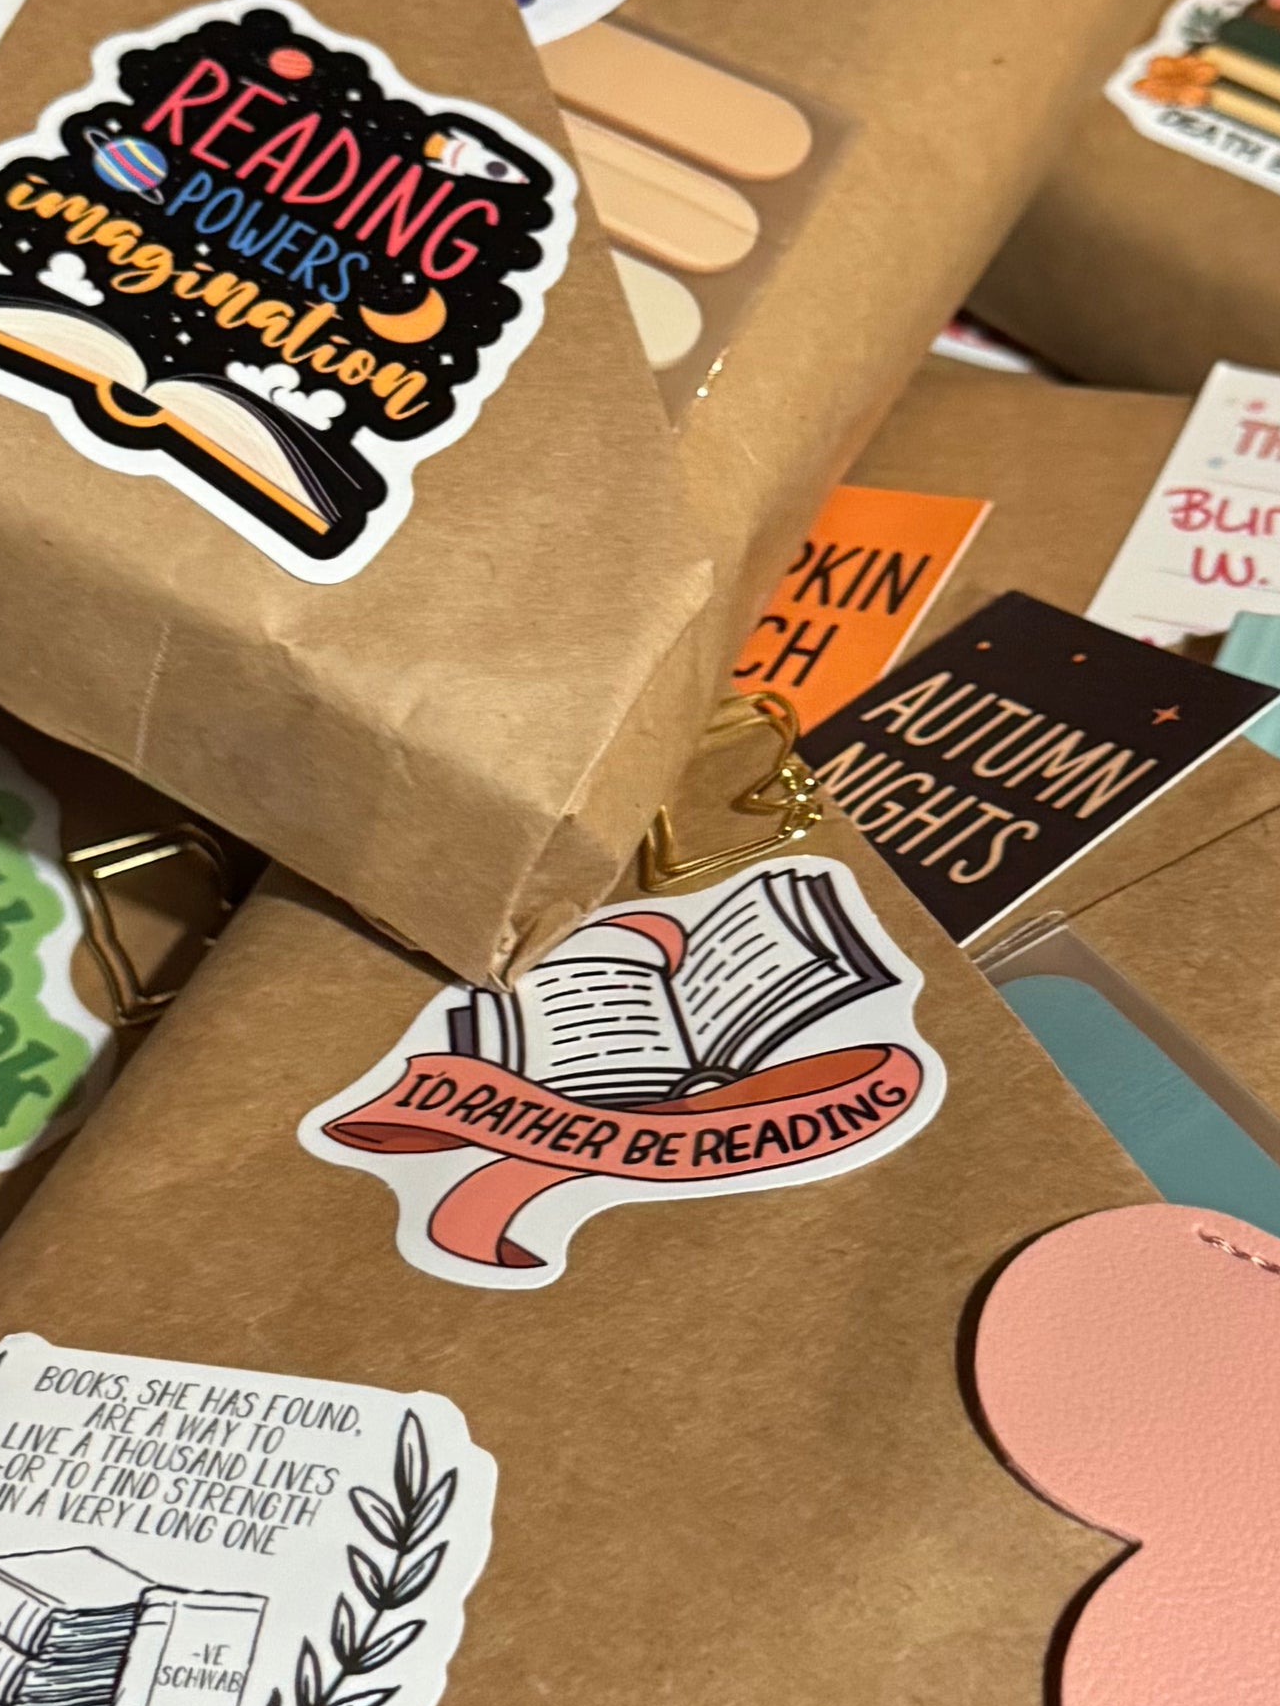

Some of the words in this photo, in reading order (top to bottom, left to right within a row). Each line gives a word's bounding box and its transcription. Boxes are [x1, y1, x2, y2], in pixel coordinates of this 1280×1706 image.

[142, 57, 501, 281] READING
[163, 170, 370, 303] POWERS
[5, 173, 431, 422] imagination
[861, 670, 1158, 821] AUTUMN
[814, 740, 1041, 885] NIGHTS
[395, 1070, 456, 1109] I'D
[447, 1082, 622, 1162] RATHER
[621, 1127, 687, 1169] BE
[691, 1078, 908, 1169] READING
[83, 1401, 149, 1435] ARE
[145, 1410, 169, 1438] A
[175, 1412, 242, 1448] WAY
[246, 1422, 286, 1455] TO
[137, 1379, 201, 1411] SHE
[199, 1385, 261, 1419] HAS
[0, 1421, 75, 1455] LIVE
[69, 1430, 94, 1459] A
[100, 1433, 248, 1482] THOUSAND
[251, 1457, 341, 1496] LIVES
[50, 1457, 91, 1490] TO
[90, 1464, 160, 1501] FIND
[163, 1477, 323, 1528] STRENGTH
[24, 1488, 52, 1518] A
[57, 1490, 135, 1530] VERY
[133, 1503, 219, 1544] LONG
[221, 1518, 290, 1557] ONE
[156, 1665, 245, 1693] SCHWAB
